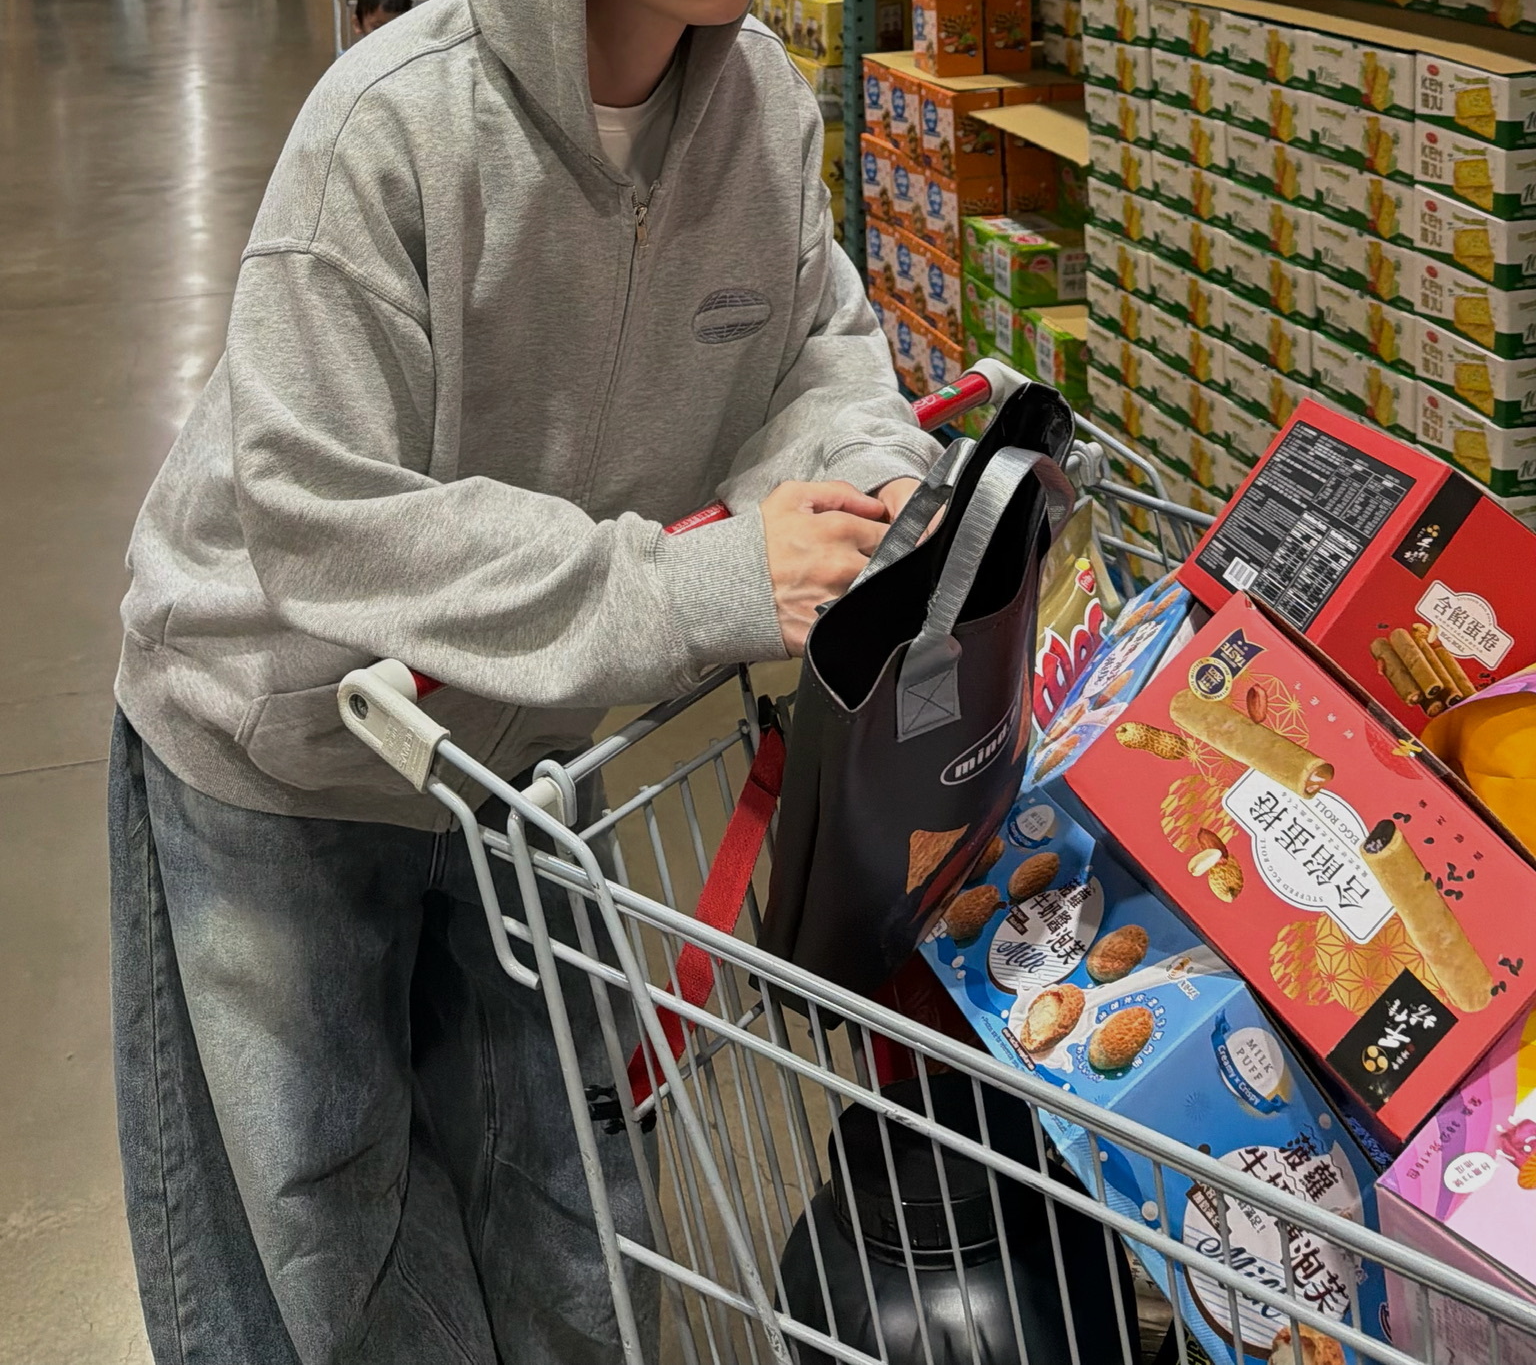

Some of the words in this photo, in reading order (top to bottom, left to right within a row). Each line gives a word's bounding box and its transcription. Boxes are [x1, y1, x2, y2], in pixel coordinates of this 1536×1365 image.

[1431, 595, 1500, 653] 含餡蛋捲
[1219, 641, 1246, 668] TASTE
[1313, 797, 1340, 826] ROLL
[1248, 789, 1371, 909] 含餡蛋捲
[1254, 838, 1270, 863] ROLL
[1337, 821, 1361, 846] EGG
[1266, 864, 1282, 884] EGG
[1281, 882, 1324, 907] STUFFED
[1031, 890, 1089, 966] 牛奶醬泡芙
[1234, 1045, 1264, 1081] PUFF
[1244, 1037, 1275, 1074] MILK
[1216, 1043, 1241, 1079] Creamy
[1237, 1080, 1261, 1106] Crispy
[1278, 1130, 1341, 1203] 菠蘿
